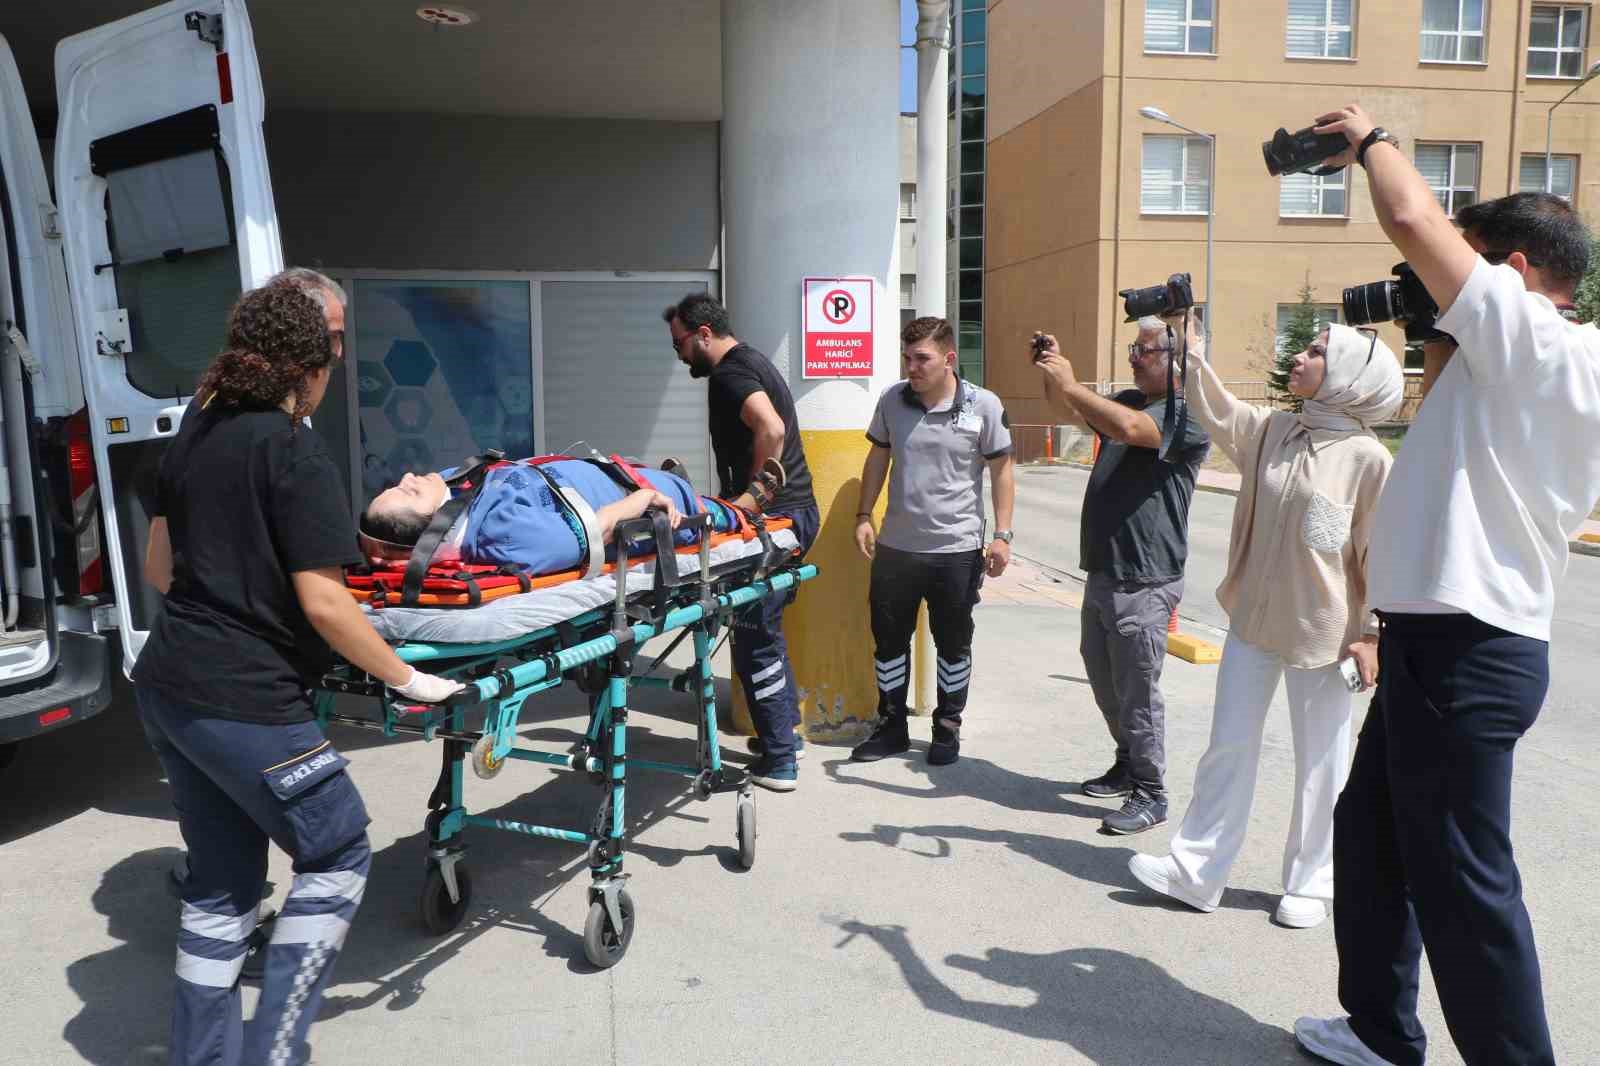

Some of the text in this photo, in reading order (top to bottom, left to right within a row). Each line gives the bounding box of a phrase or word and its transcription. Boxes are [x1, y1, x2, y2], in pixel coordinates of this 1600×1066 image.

[834, 296, 849, 318] P
[815, 339, 863, 347] AMBULANS
[825, 349, 853, 358] HARİCİ
[807, 361, 873, 369] PARK YAPILMAZ
